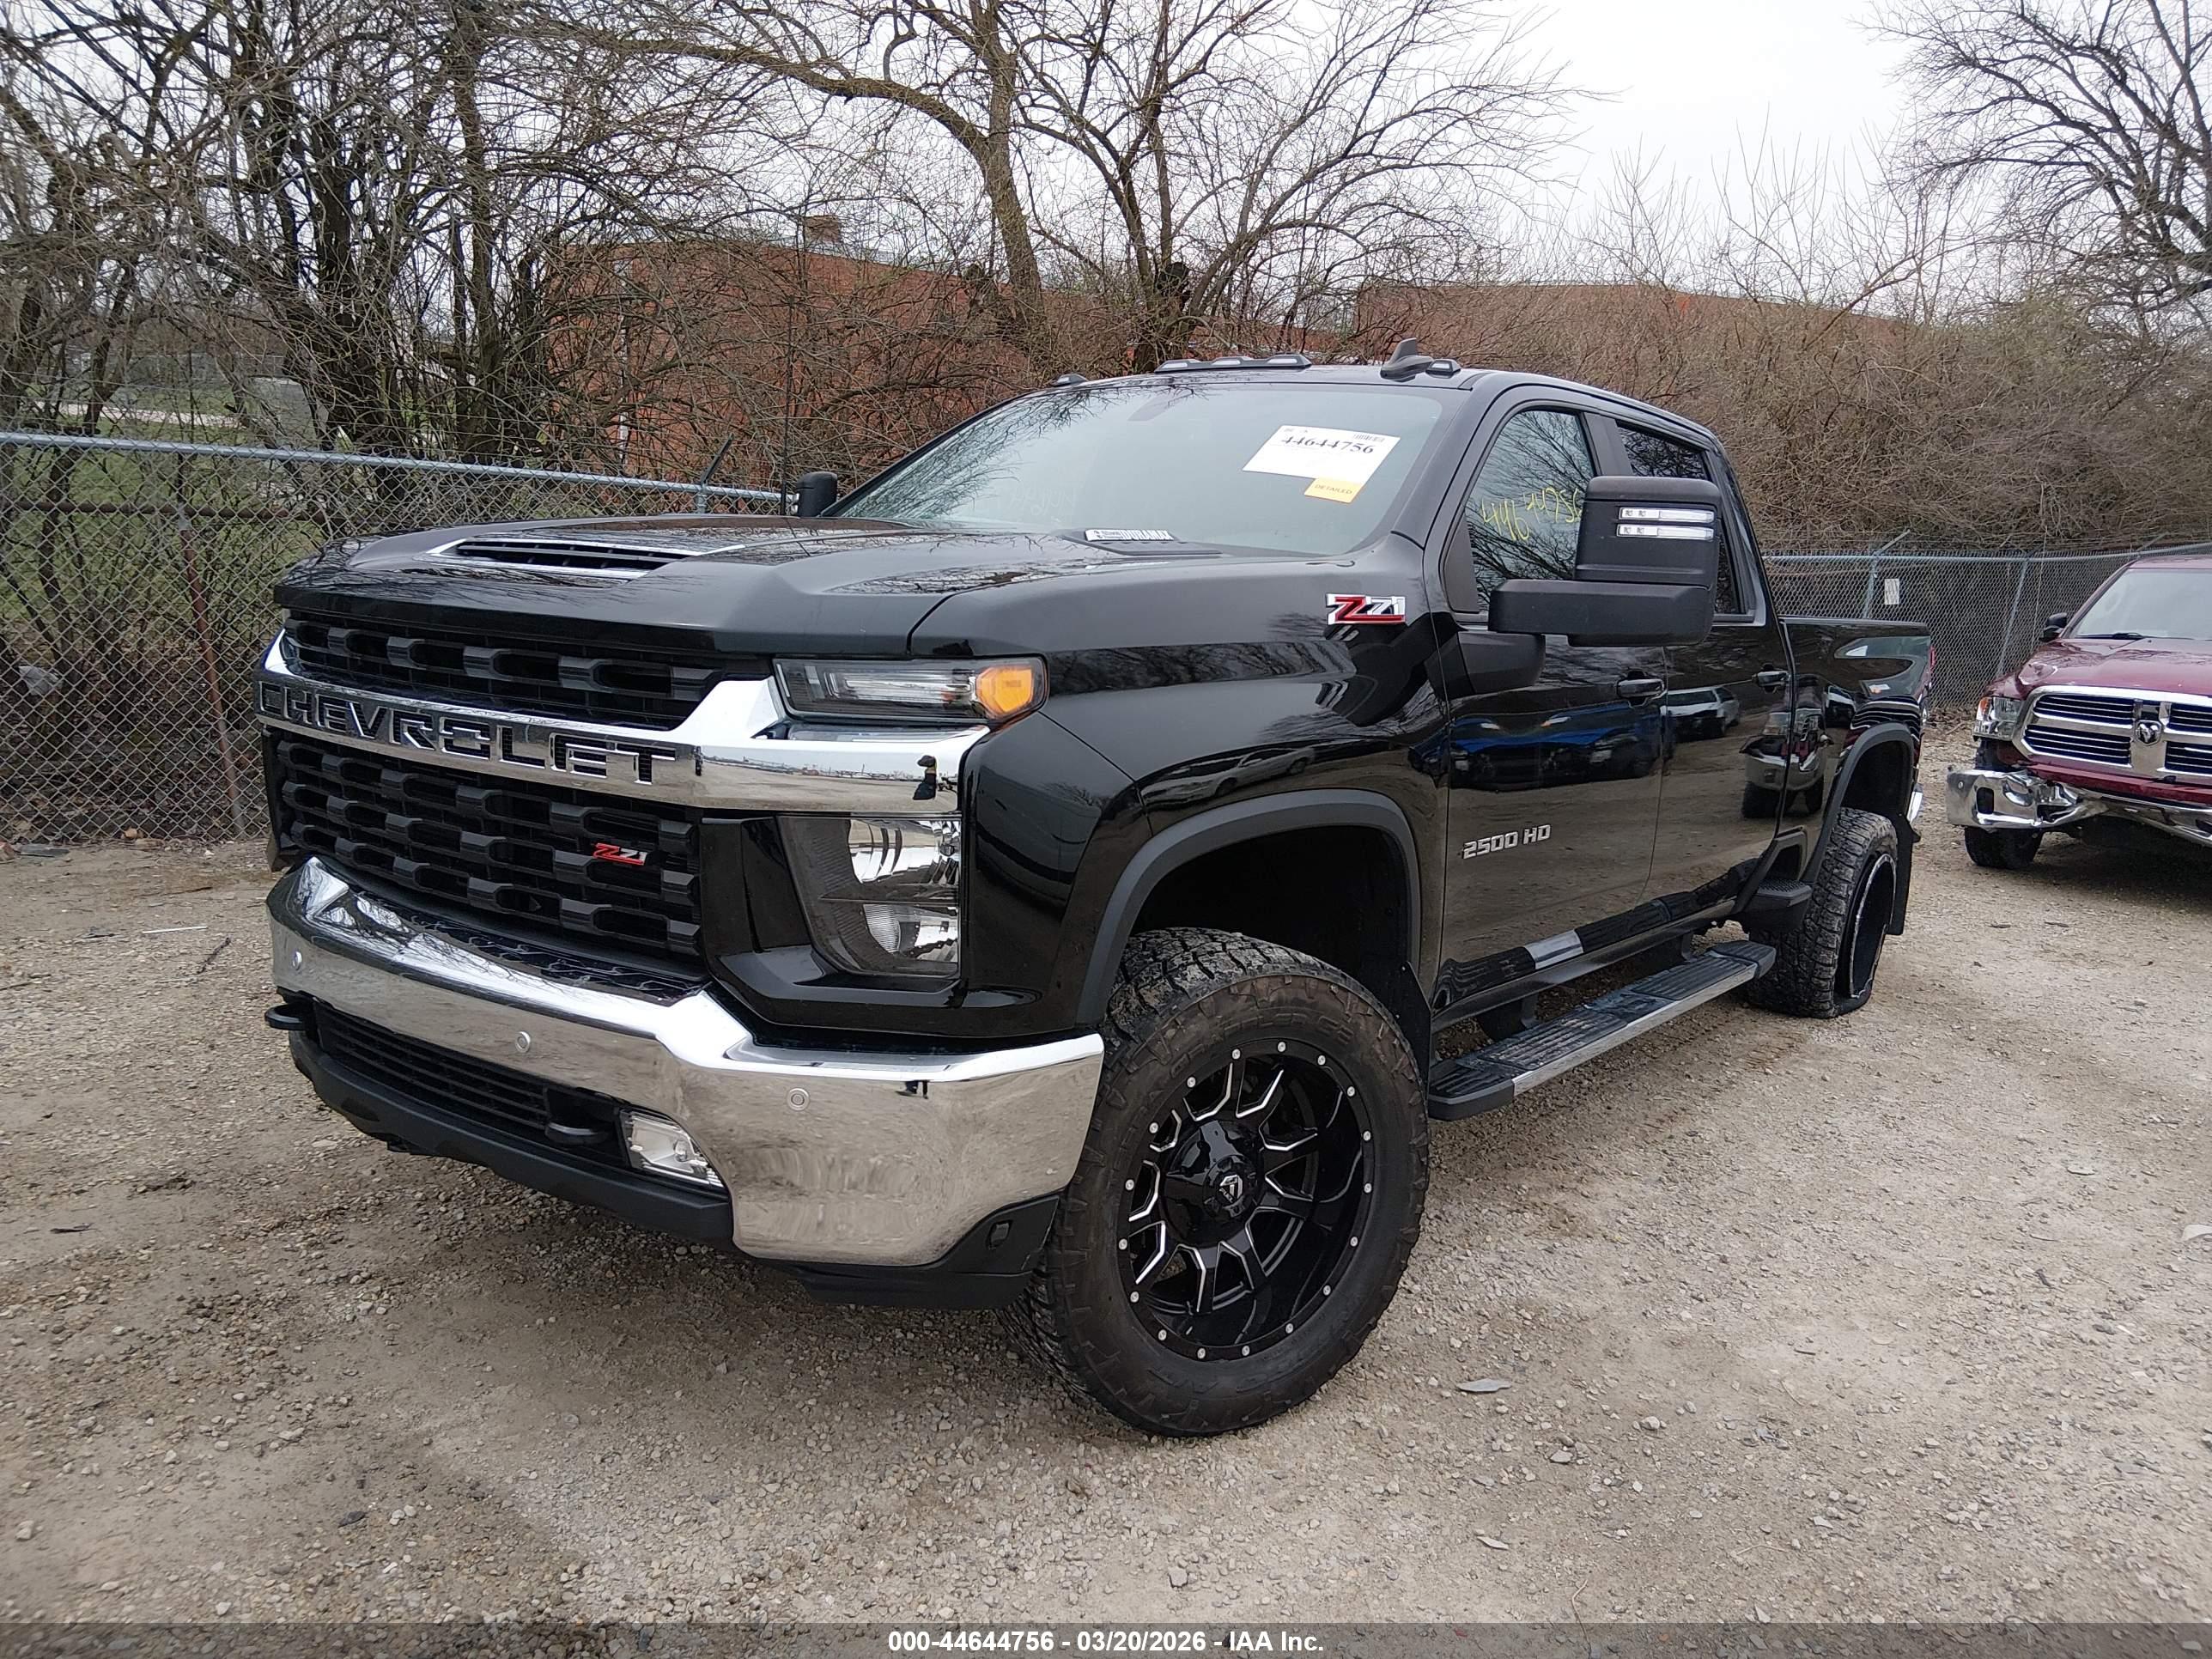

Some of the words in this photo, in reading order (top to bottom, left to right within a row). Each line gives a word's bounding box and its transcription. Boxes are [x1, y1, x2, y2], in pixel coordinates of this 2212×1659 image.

[1281, 435, 1376, 454] 44644756
[1314, 483, 1353, 495] DETAILED
[1326, 593, 1407, 625] Z71
[259, 681, 678, 785] CHEVROLET
[592, 842, 648, 866] Z71
[1462, 831, 1519, 860] 2500
[1522, 824, 1552, 845] HD
